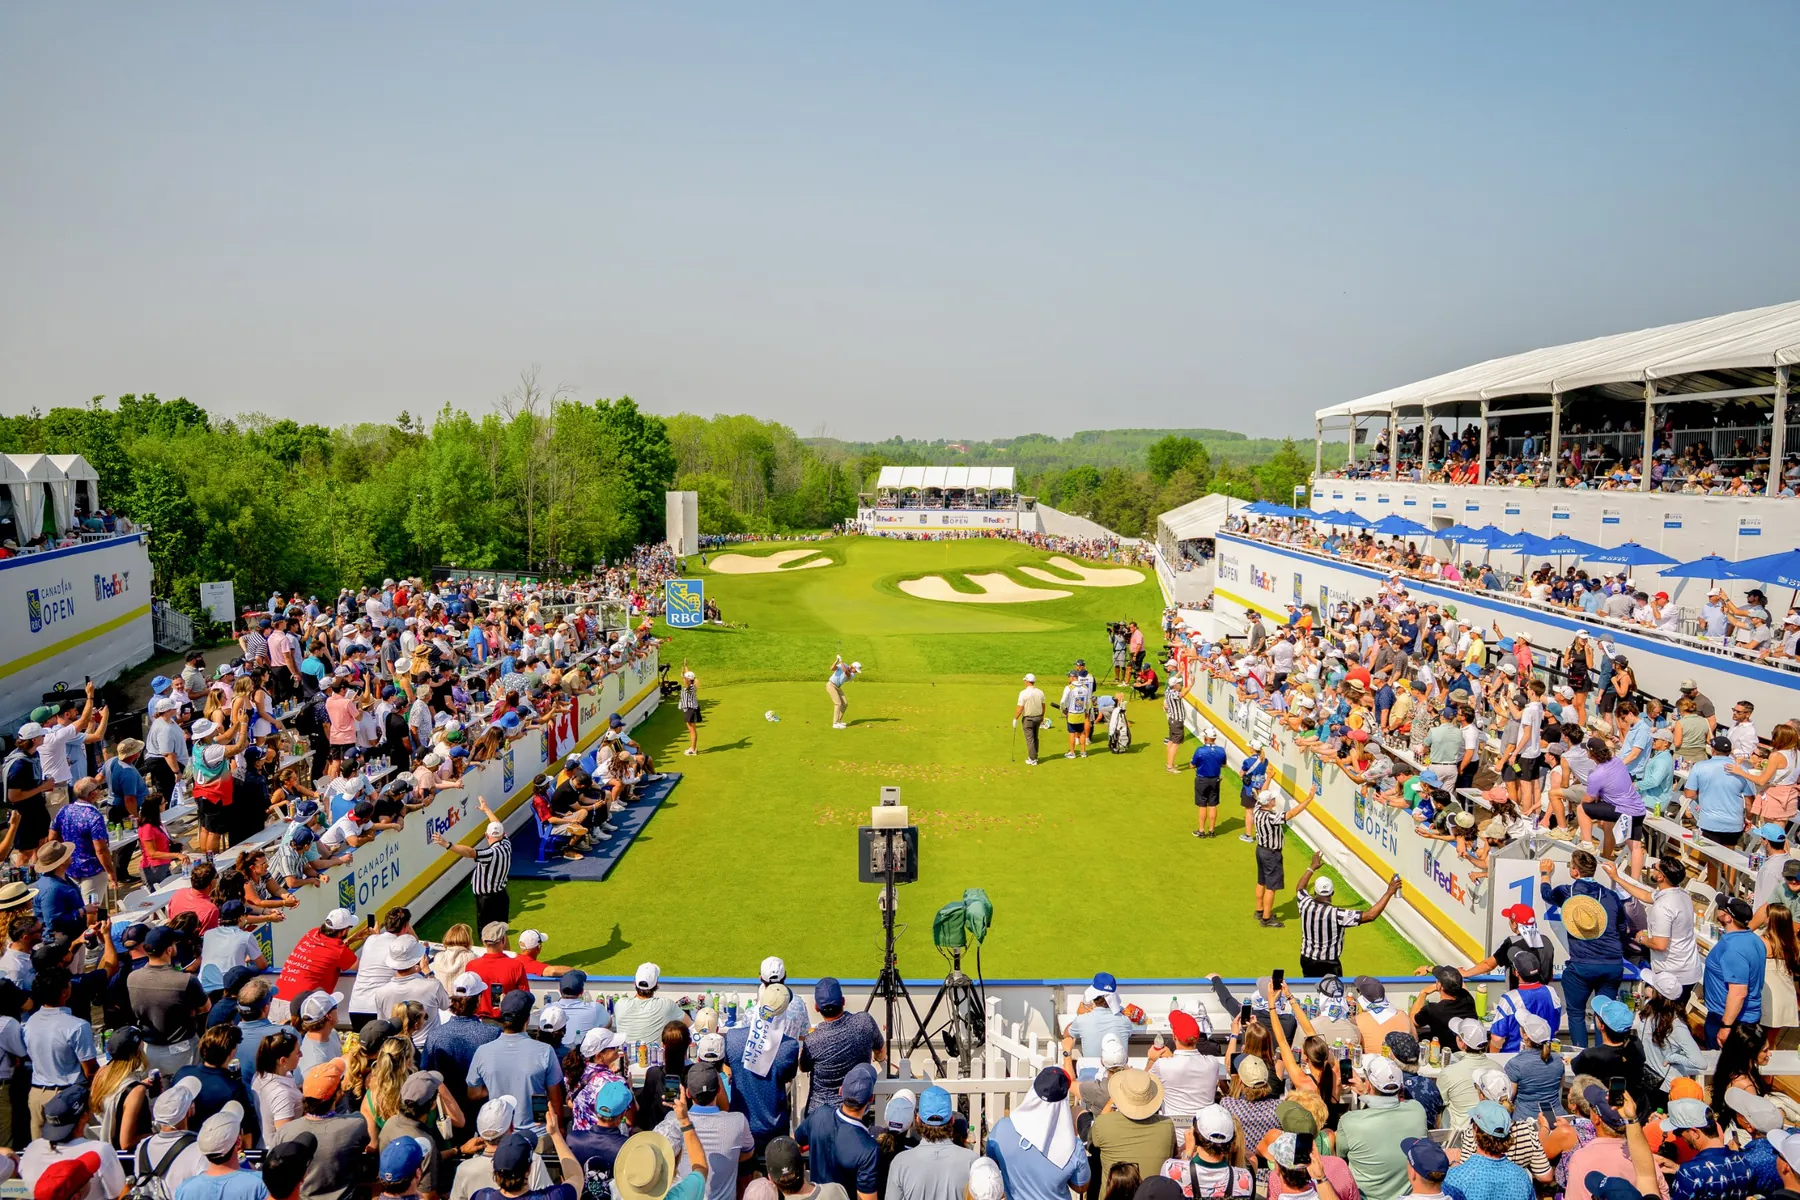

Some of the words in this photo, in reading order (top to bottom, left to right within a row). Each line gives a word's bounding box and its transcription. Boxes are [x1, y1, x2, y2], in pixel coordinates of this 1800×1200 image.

[860, 512, 872, 521] 14
[101, 573, 124, 600] FedEx
[1223, 565, 1238, 582] OPEN
[1255, 568, 1270, 591] FedEx
[41, 578, 72, 599] CANADIAN
[31, 618, 42, 631] RBC
[43, 597, 75, 625] OPEN
[671, 612, 699, 623] RBC
[584, 703, 598, 721] FedEx
[435, 806, 460, 835] FedEx
[1366, 816, 1397, 856] OPEN
[358, 841, 399, 879] CANADIAN
[358, 858, 400, 905] OPEN
[1433, 860, 1466, 905] FedEx
[744, 1020, 763, 1062] OPEN
[751, 1024, 769, 1065] CANADIAN
